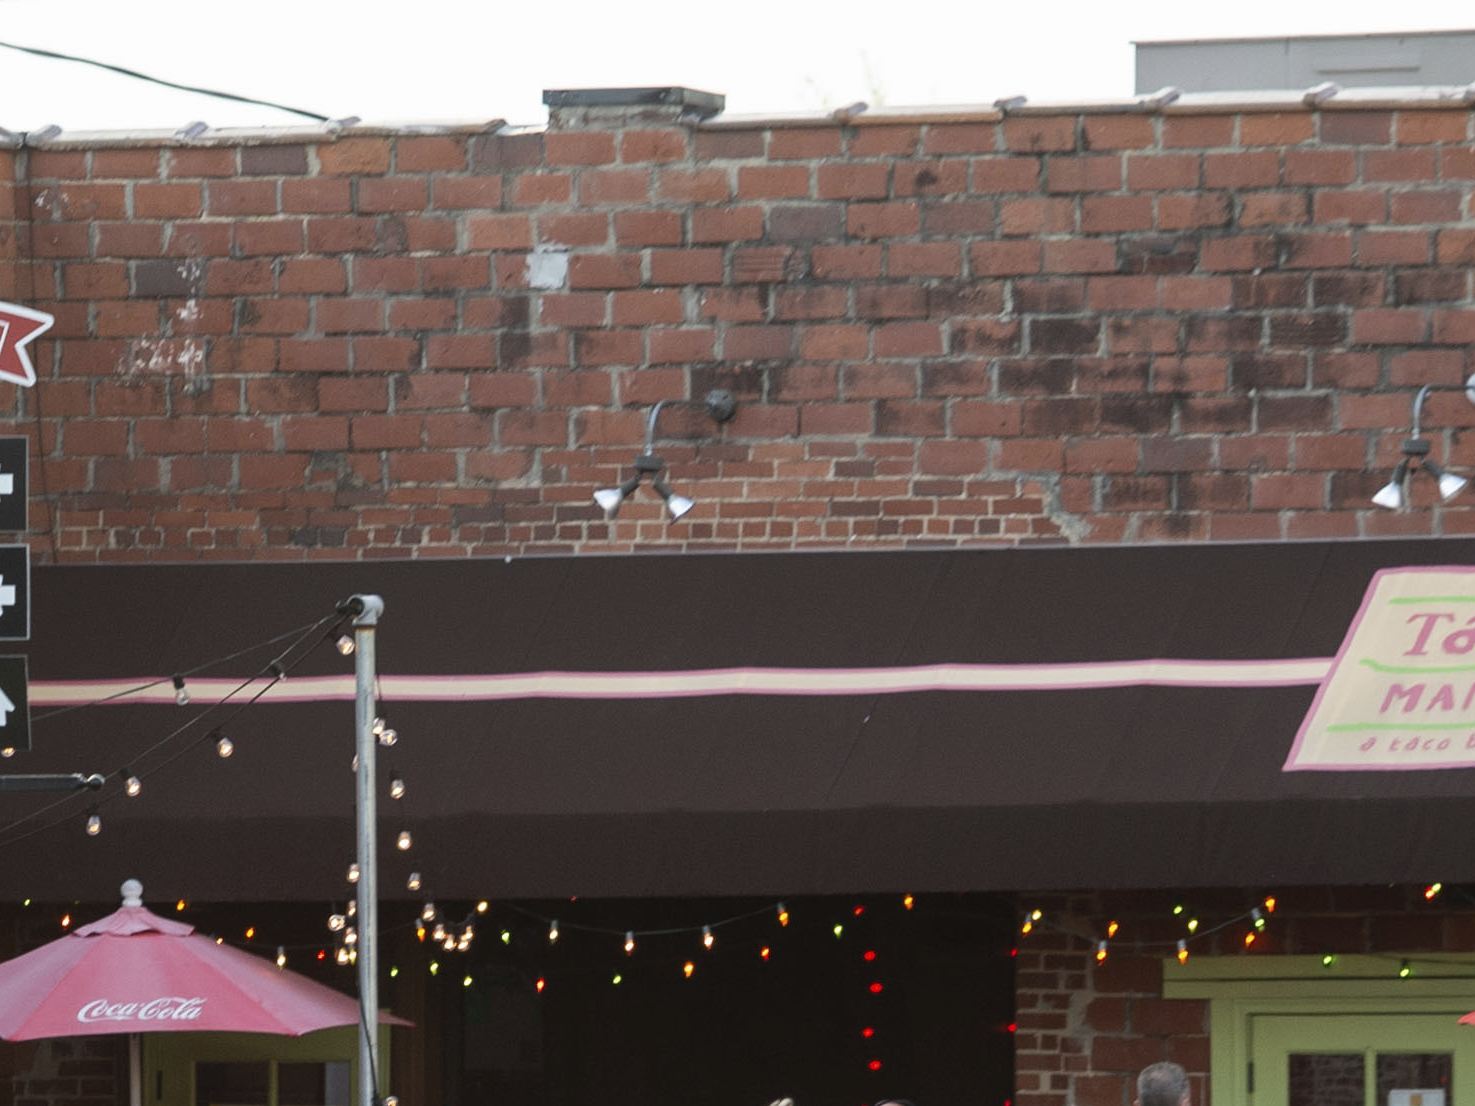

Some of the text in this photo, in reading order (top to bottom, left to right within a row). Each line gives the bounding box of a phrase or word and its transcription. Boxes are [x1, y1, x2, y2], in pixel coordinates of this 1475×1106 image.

[1403, 613, 1475, 656] Ta
[1379, 682, 1475, 714] MA
[1389, 735, 1451, 751] taco
[77, 996, 207, 1023] Coca-Cola
